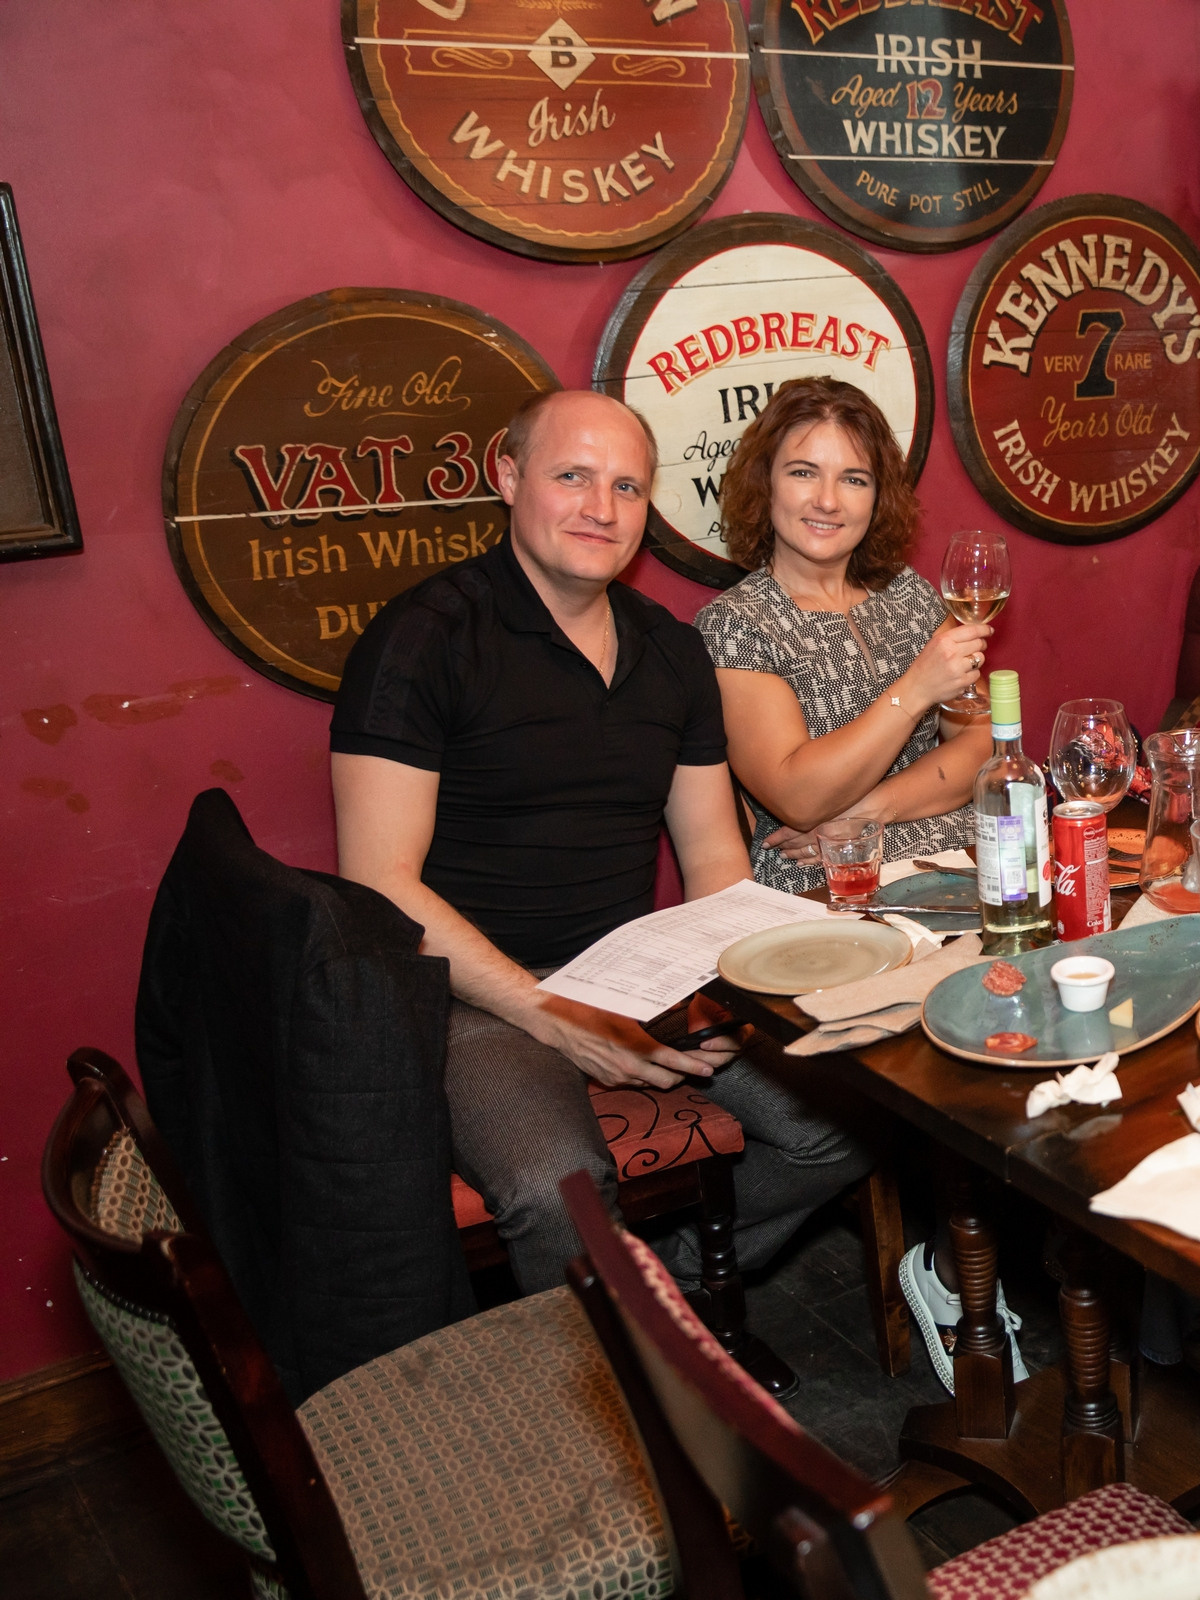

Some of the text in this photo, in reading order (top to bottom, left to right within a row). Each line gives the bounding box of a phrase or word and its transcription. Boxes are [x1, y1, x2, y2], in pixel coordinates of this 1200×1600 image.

[551, 36, 577, 70] B
[875, 33, 982, 79] IRISH
[528, 89, 616, 147] Irish
[831, 74, 1018, 122] Aged 12 Years
[452, 111, 674, 204] WHISKEY
[842, 119, 1007, 158] WHISKEY
[856, 170, 999, 214] PURE POT STILL
[647, 312, 891, 396] REDBREAST
[1044, 308, 1152, 401] VERY 7 RARE
[303, 355, 473, 418] Fine Old
[1040, 396, 1159, 448] Years Old
[234, 434, 414, 525] VAT
[993, 412, 1191, 513] IRISH WHISKEY
[249, 534, 347, 581] Irish
